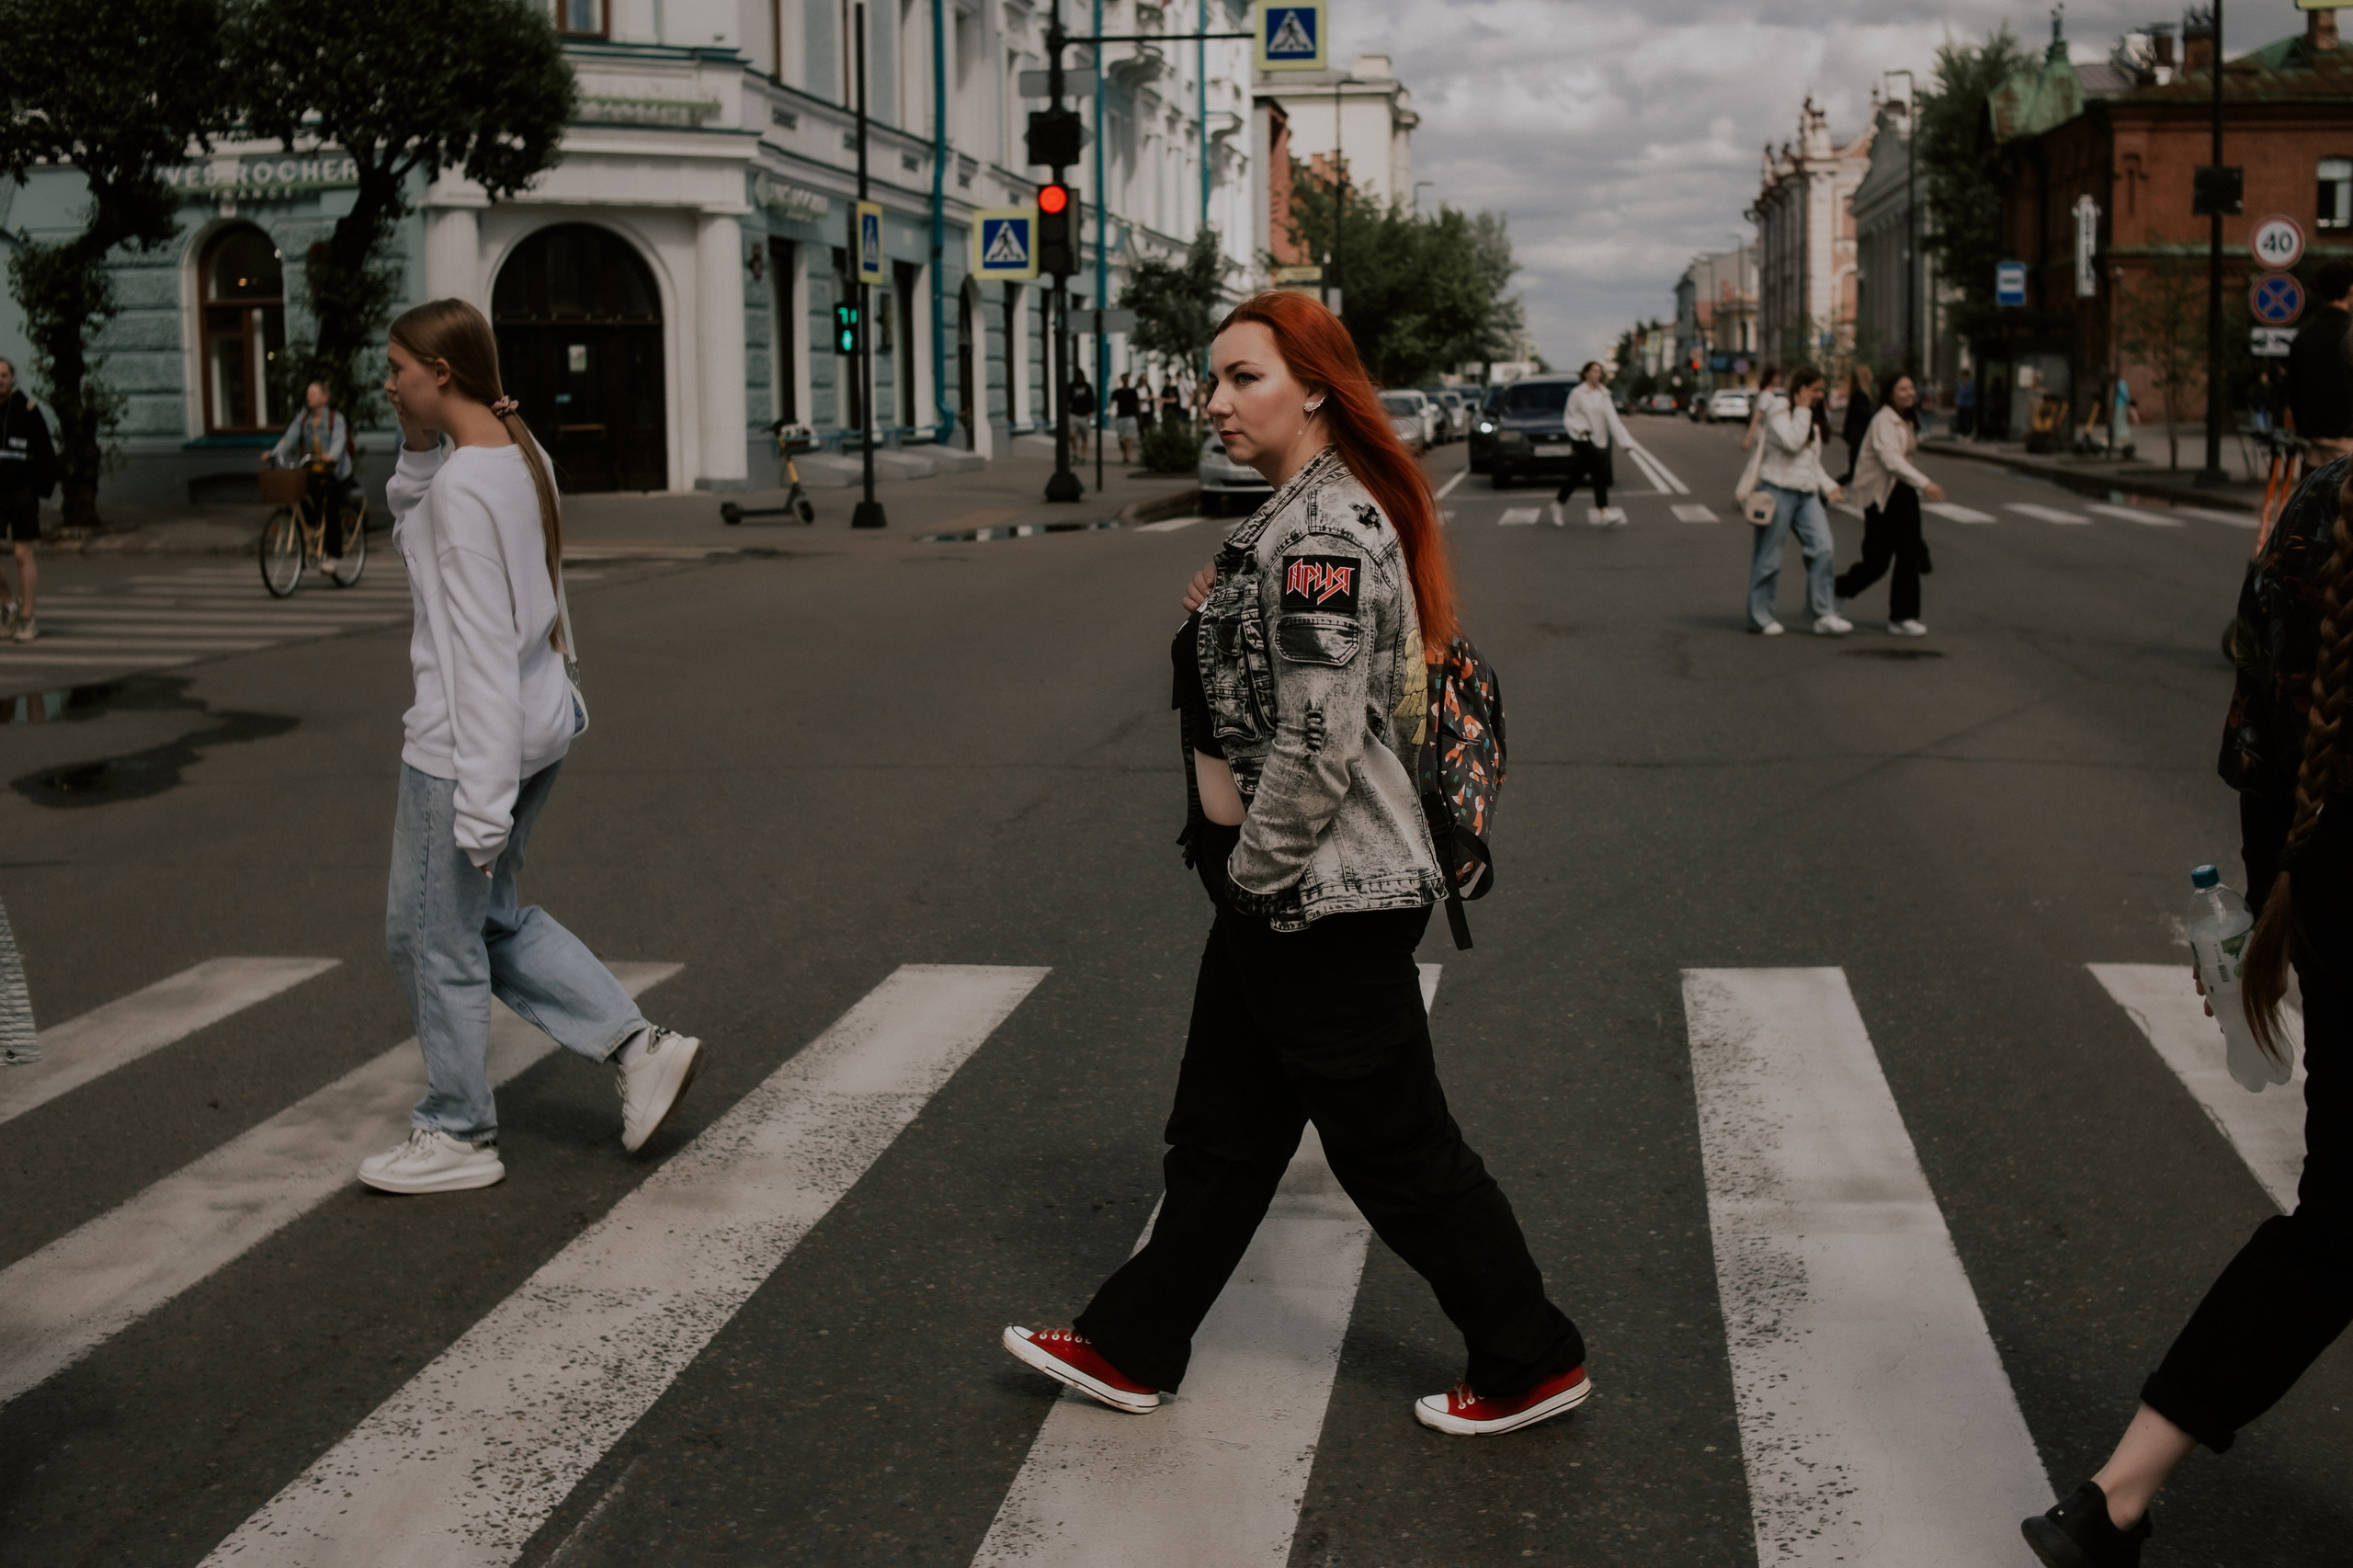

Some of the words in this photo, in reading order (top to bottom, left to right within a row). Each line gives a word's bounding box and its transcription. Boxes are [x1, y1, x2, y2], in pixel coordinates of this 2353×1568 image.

[236, 157, 359, 186] ROCHER
[2261, 230, 2293, 254] 40
[1286, 557, 1356, 606] АРИЯ
